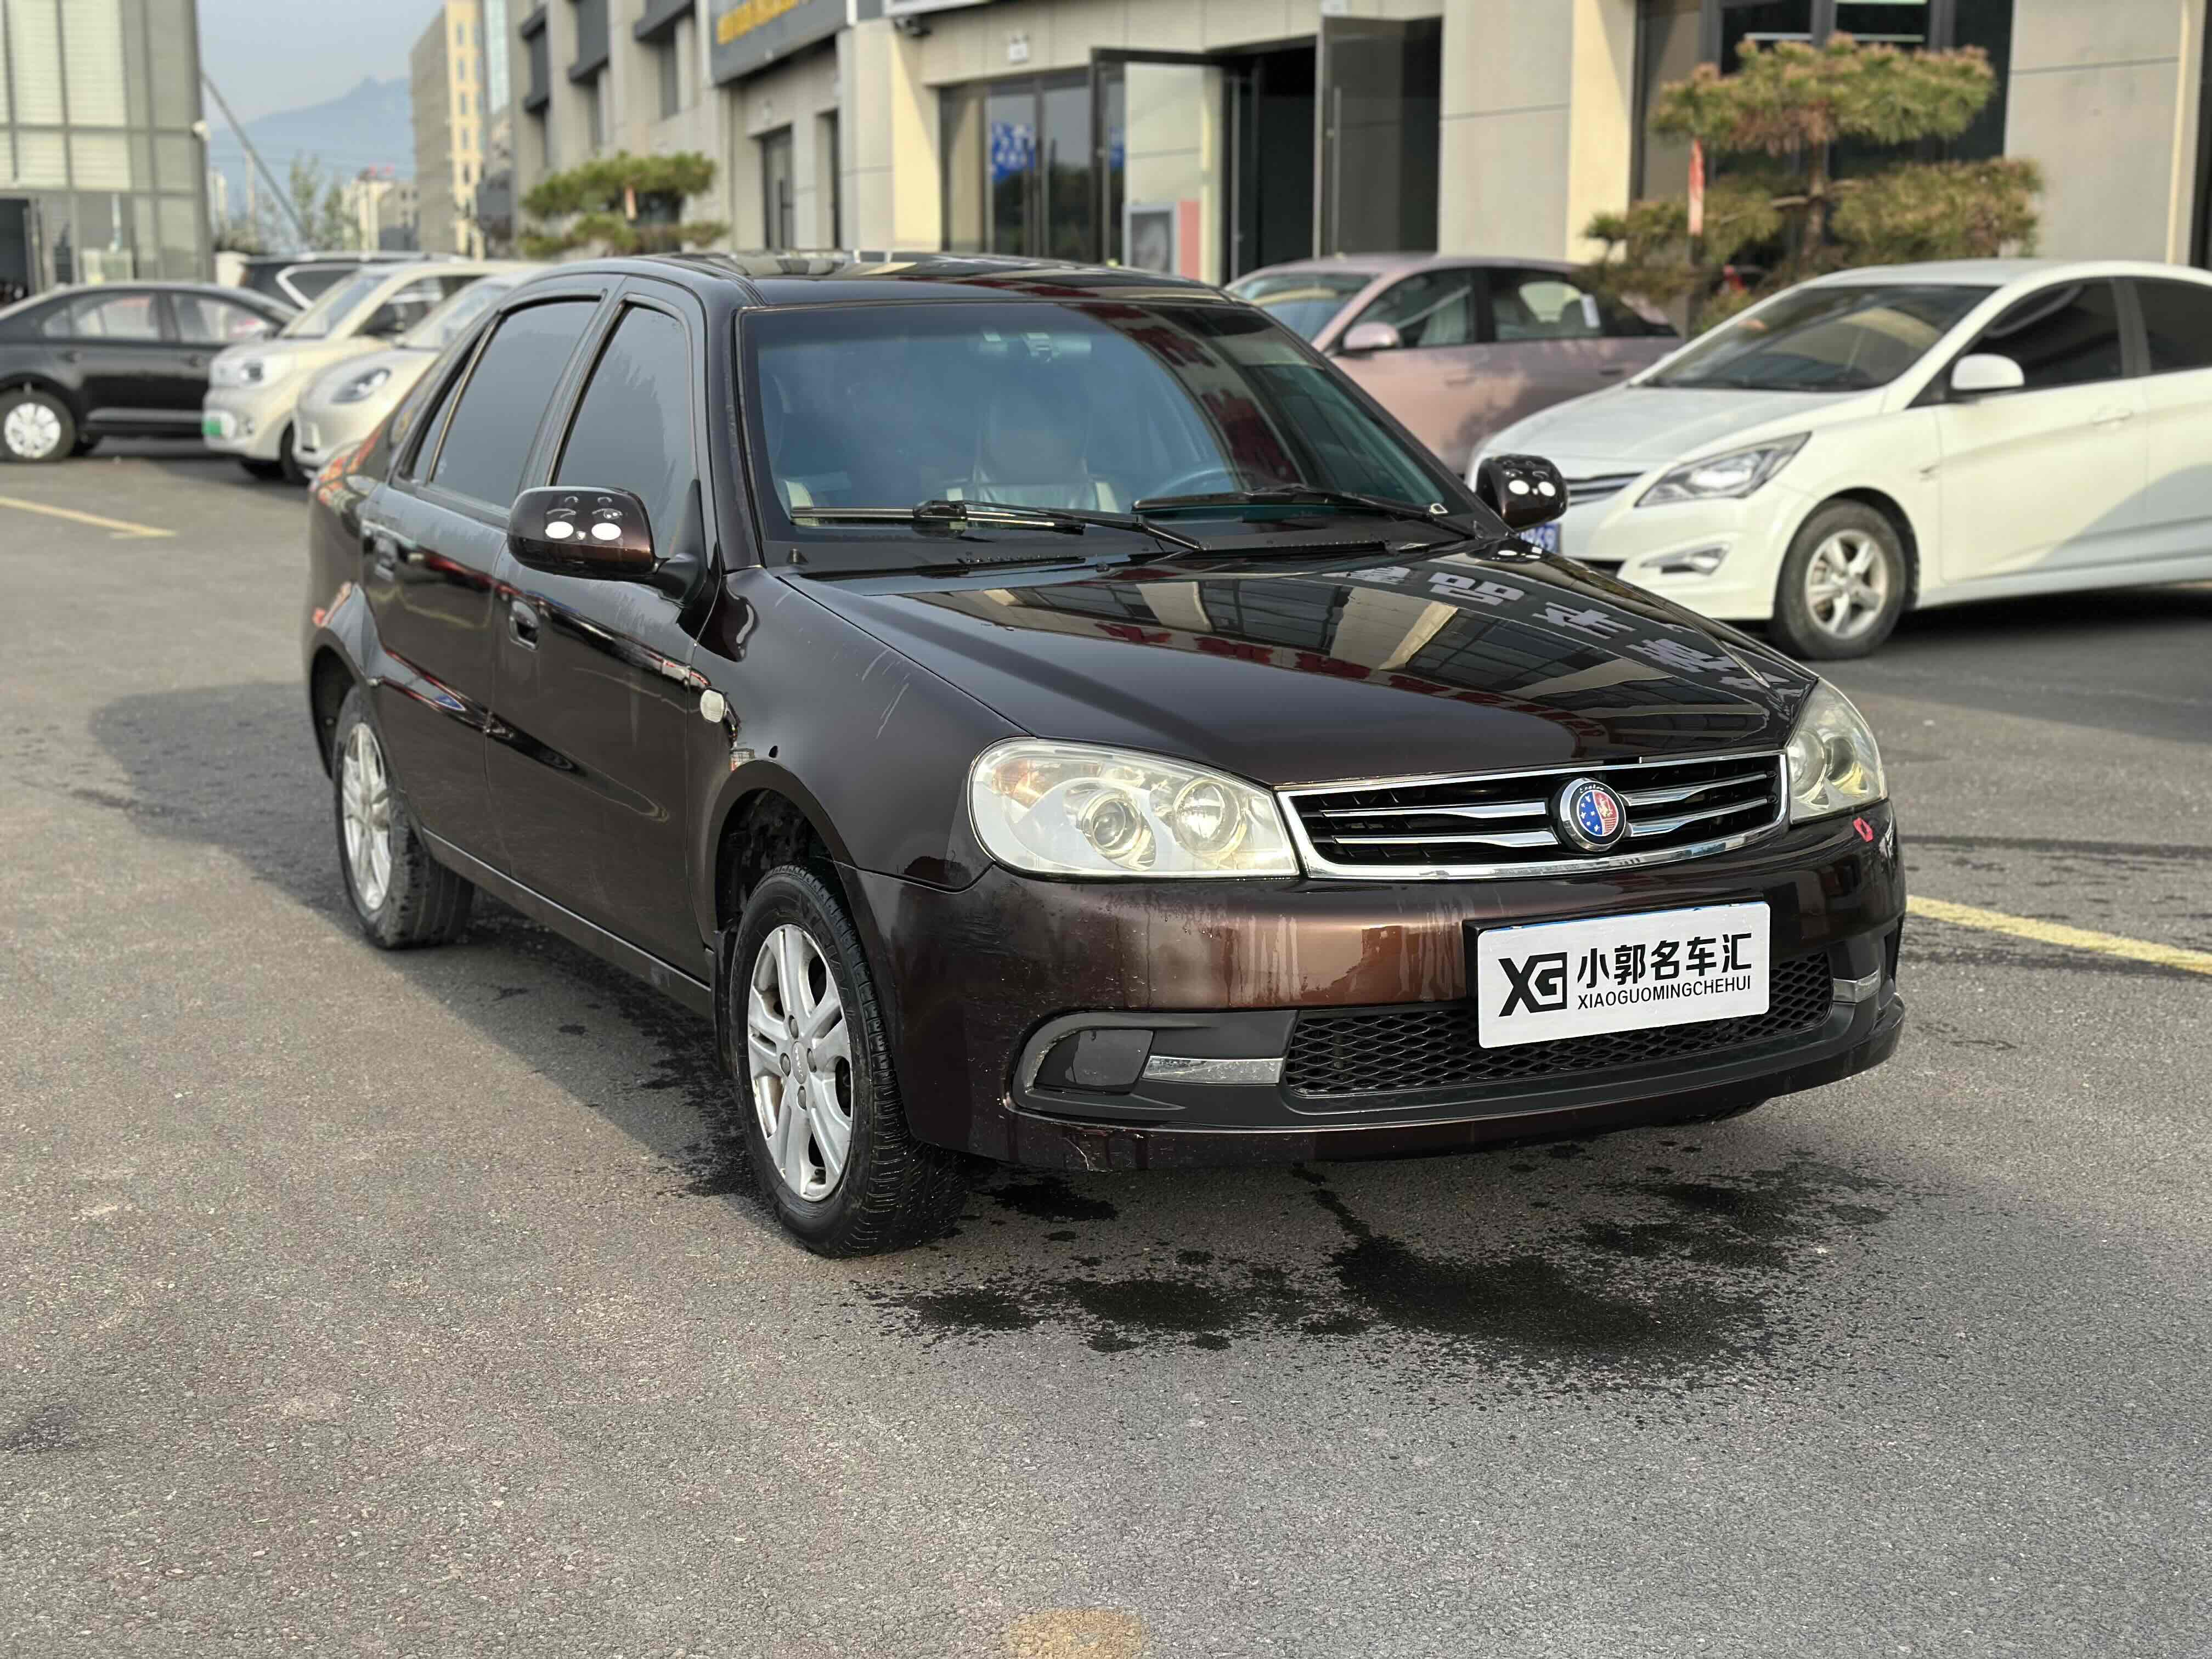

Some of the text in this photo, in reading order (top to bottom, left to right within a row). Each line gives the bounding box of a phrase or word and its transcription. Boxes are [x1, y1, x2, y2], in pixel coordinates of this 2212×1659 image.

[1498, 952, 1567, 1017] XG
[1577, 933, 1752, 989] 小郭名车汇
[1577, 975, 1751, 1010] XIAOGUOMINGCHEHUI
